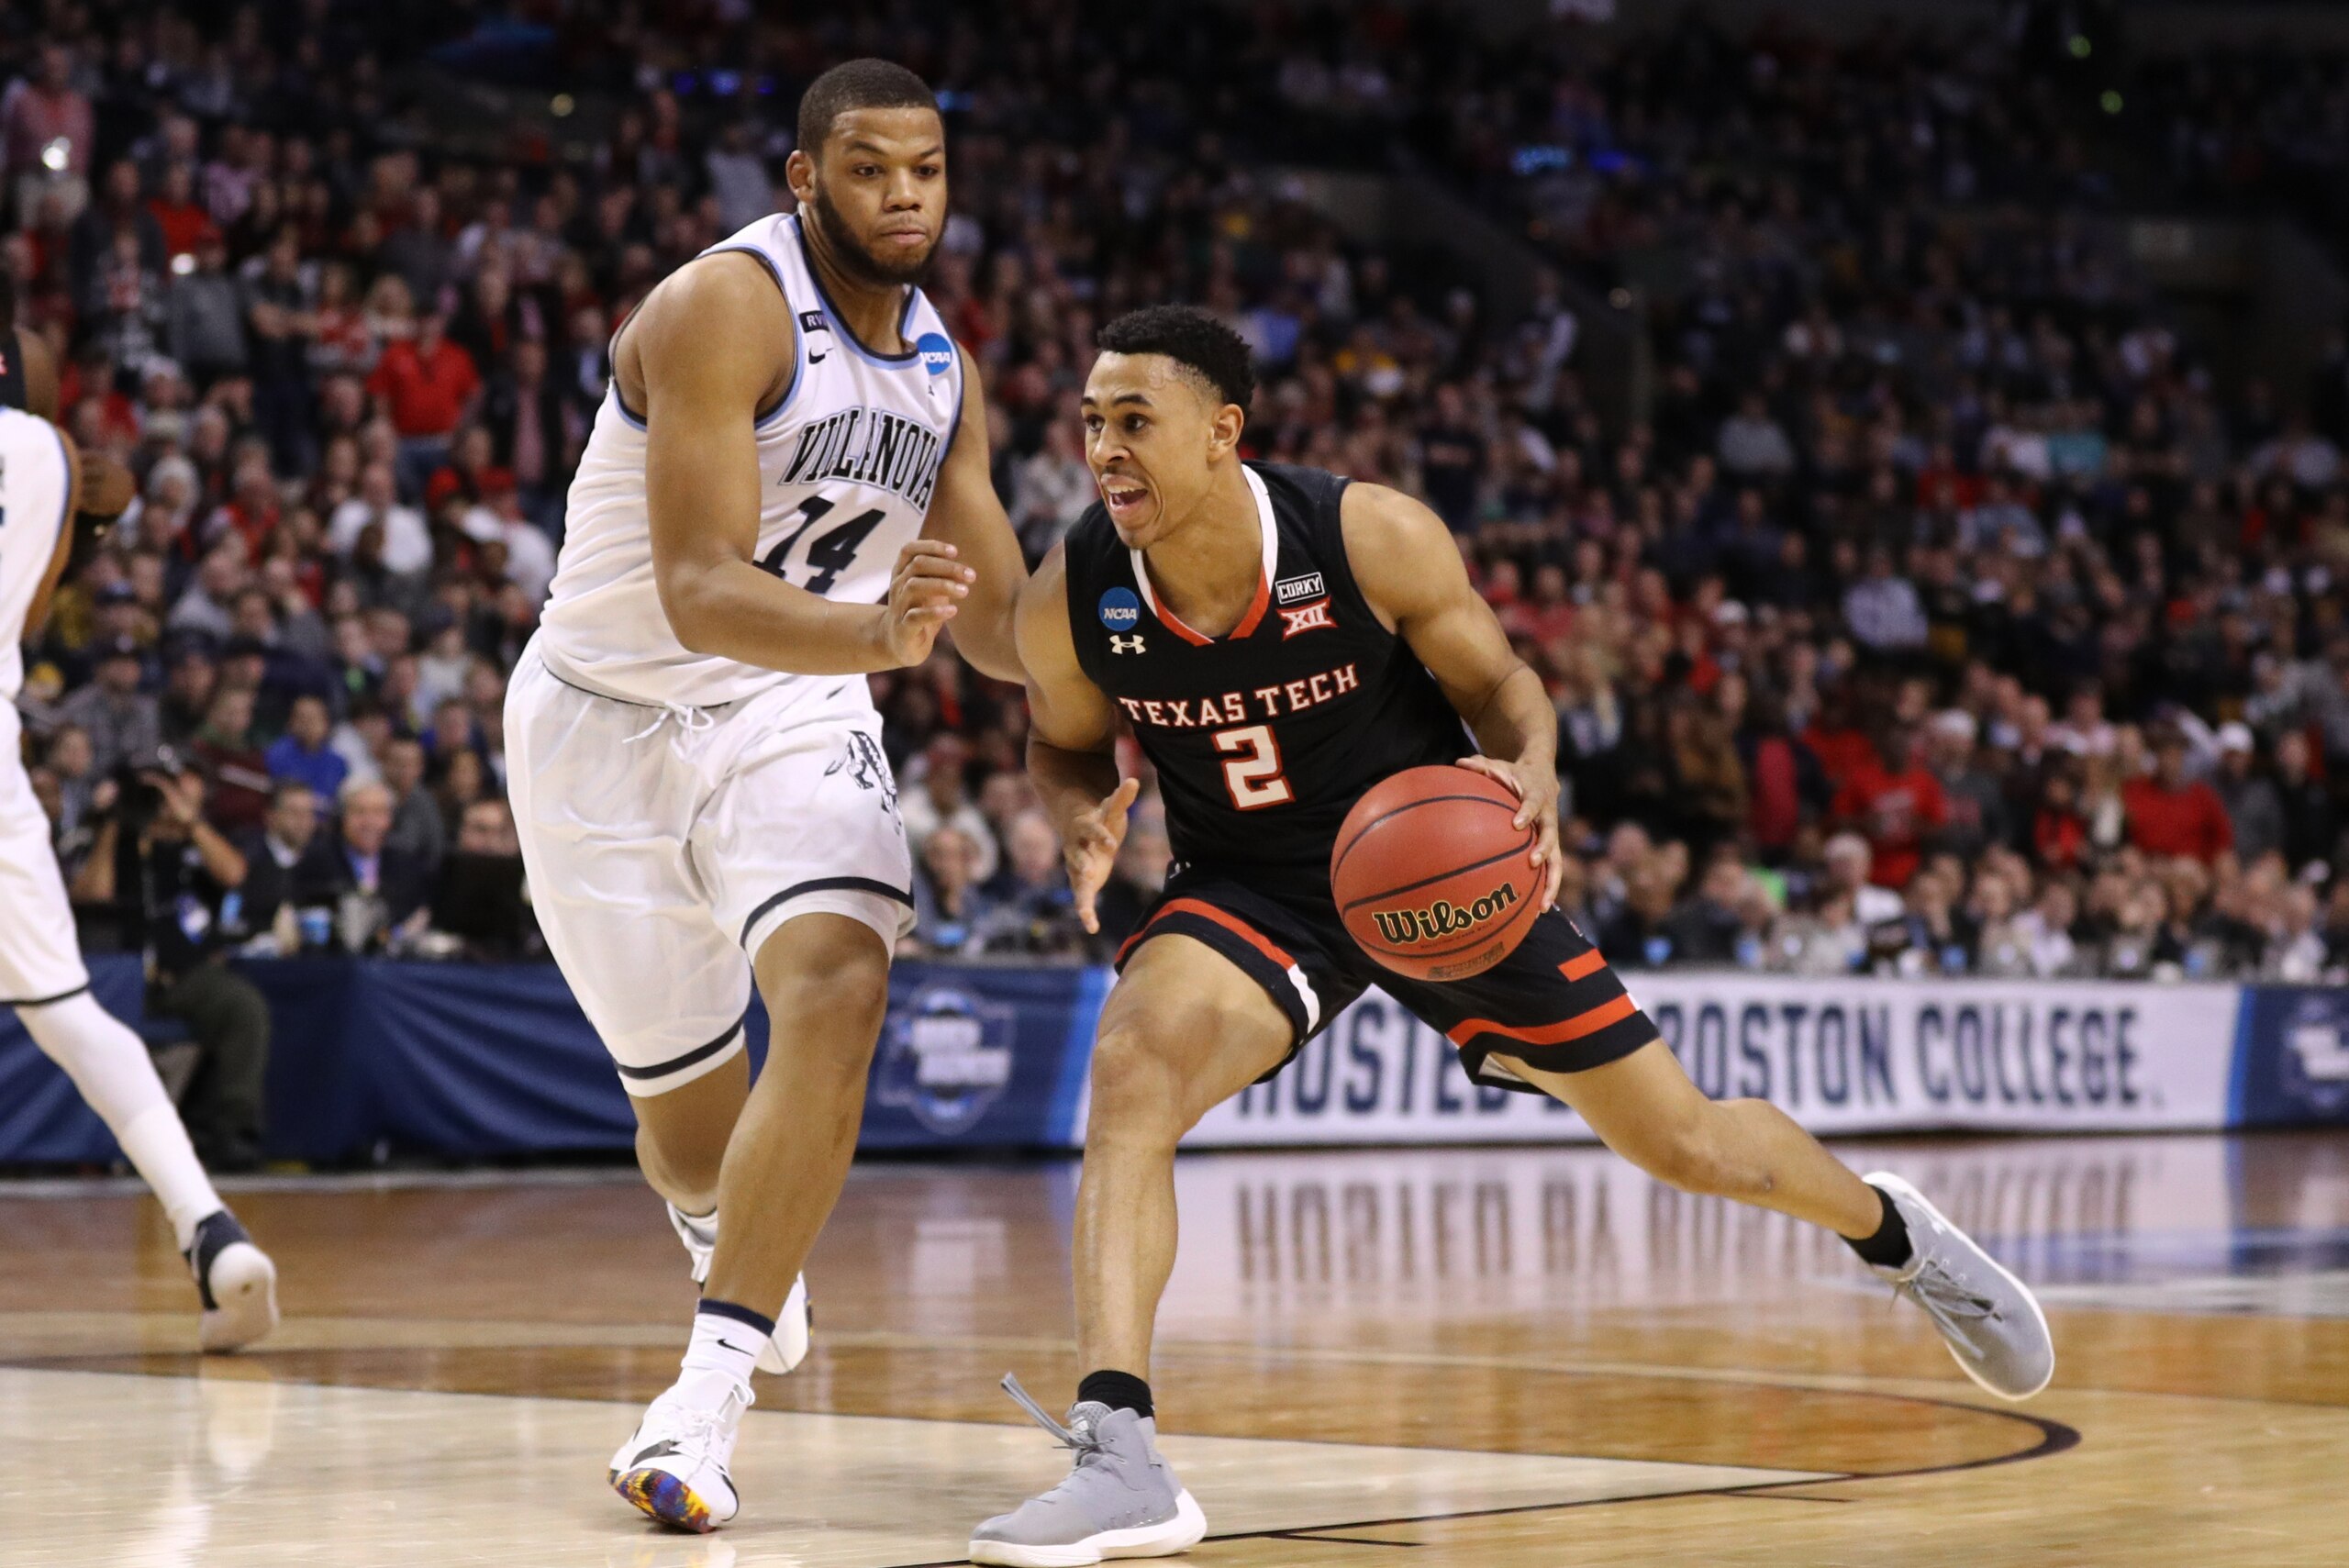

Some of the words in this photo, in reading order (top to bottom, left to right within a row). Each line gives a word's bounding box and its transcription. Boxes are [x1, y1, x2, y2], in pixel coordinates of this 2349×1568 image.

[752, 495, 886, 595] 14
[1103, 607, 1137, 619] NCAA
[1278, 577, 1321, 599] CORKY
[1279, 600, 1333, 637] XII
[1117, 692, 1247, 727] TEXAS
[1254, 662, 1360, 717] TECH
[1210, 724, 1296, 811] 2
[1373, 882, 1519, 944] Wilson
[1239, 1000, 1513, 1114] OSTE
[1916, 1003, 2138, 1106] COLLEGE
